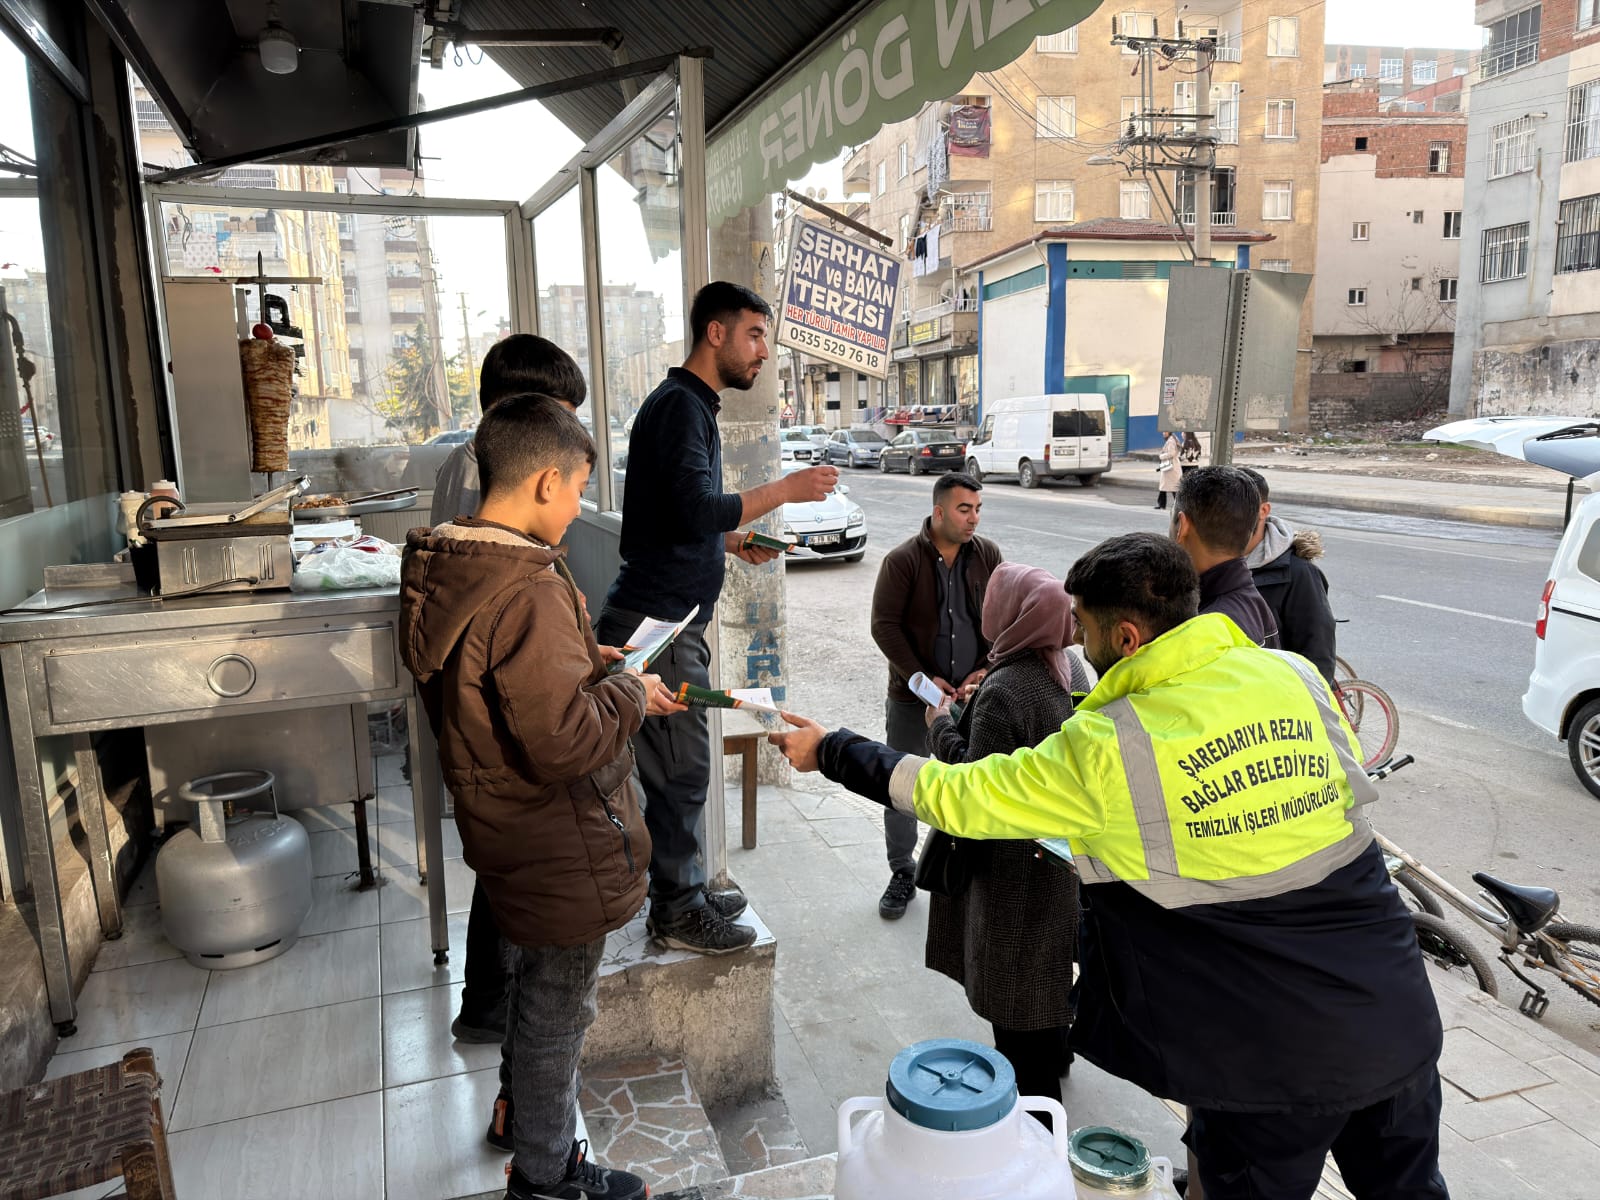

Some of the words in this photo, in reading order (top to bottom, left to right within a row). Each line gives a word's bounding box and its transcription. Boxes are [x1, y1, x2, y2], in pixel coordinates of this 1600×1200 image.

[791, 250, 823, 280] BAY
[825, 266, 842, 288] ve
[845, 271, 894, 308] BAYAN
[799, 226, 893, 281] SERHAT
[787, 305, 804, 321] HER
[805, 309, 831, 331] TÜRLÜ
[832, 320, 855, 340] TAMİR
[857, 329, 886, 350] YAPILIR
[795, 277, 885, 331] TERZİSİ
[790, 327, 821, 348] 0535
[823, 339, 846, 356] 529
[849, 347, 863, 362] 76
[866, 353, 879, 368] 18
[1177, 722, 1269, 783] ŞAREDARIYA
[1269, 718, 1313, 742] REZAN
[1180, 769, 1247, 814] BAĞLAR
[1245, 749, 1330, 787] BELEDİYESİ
[1185, 812, 1242, 838] TEMİZLİK
[1242, 801, 1280, 835] İŞLERİ
